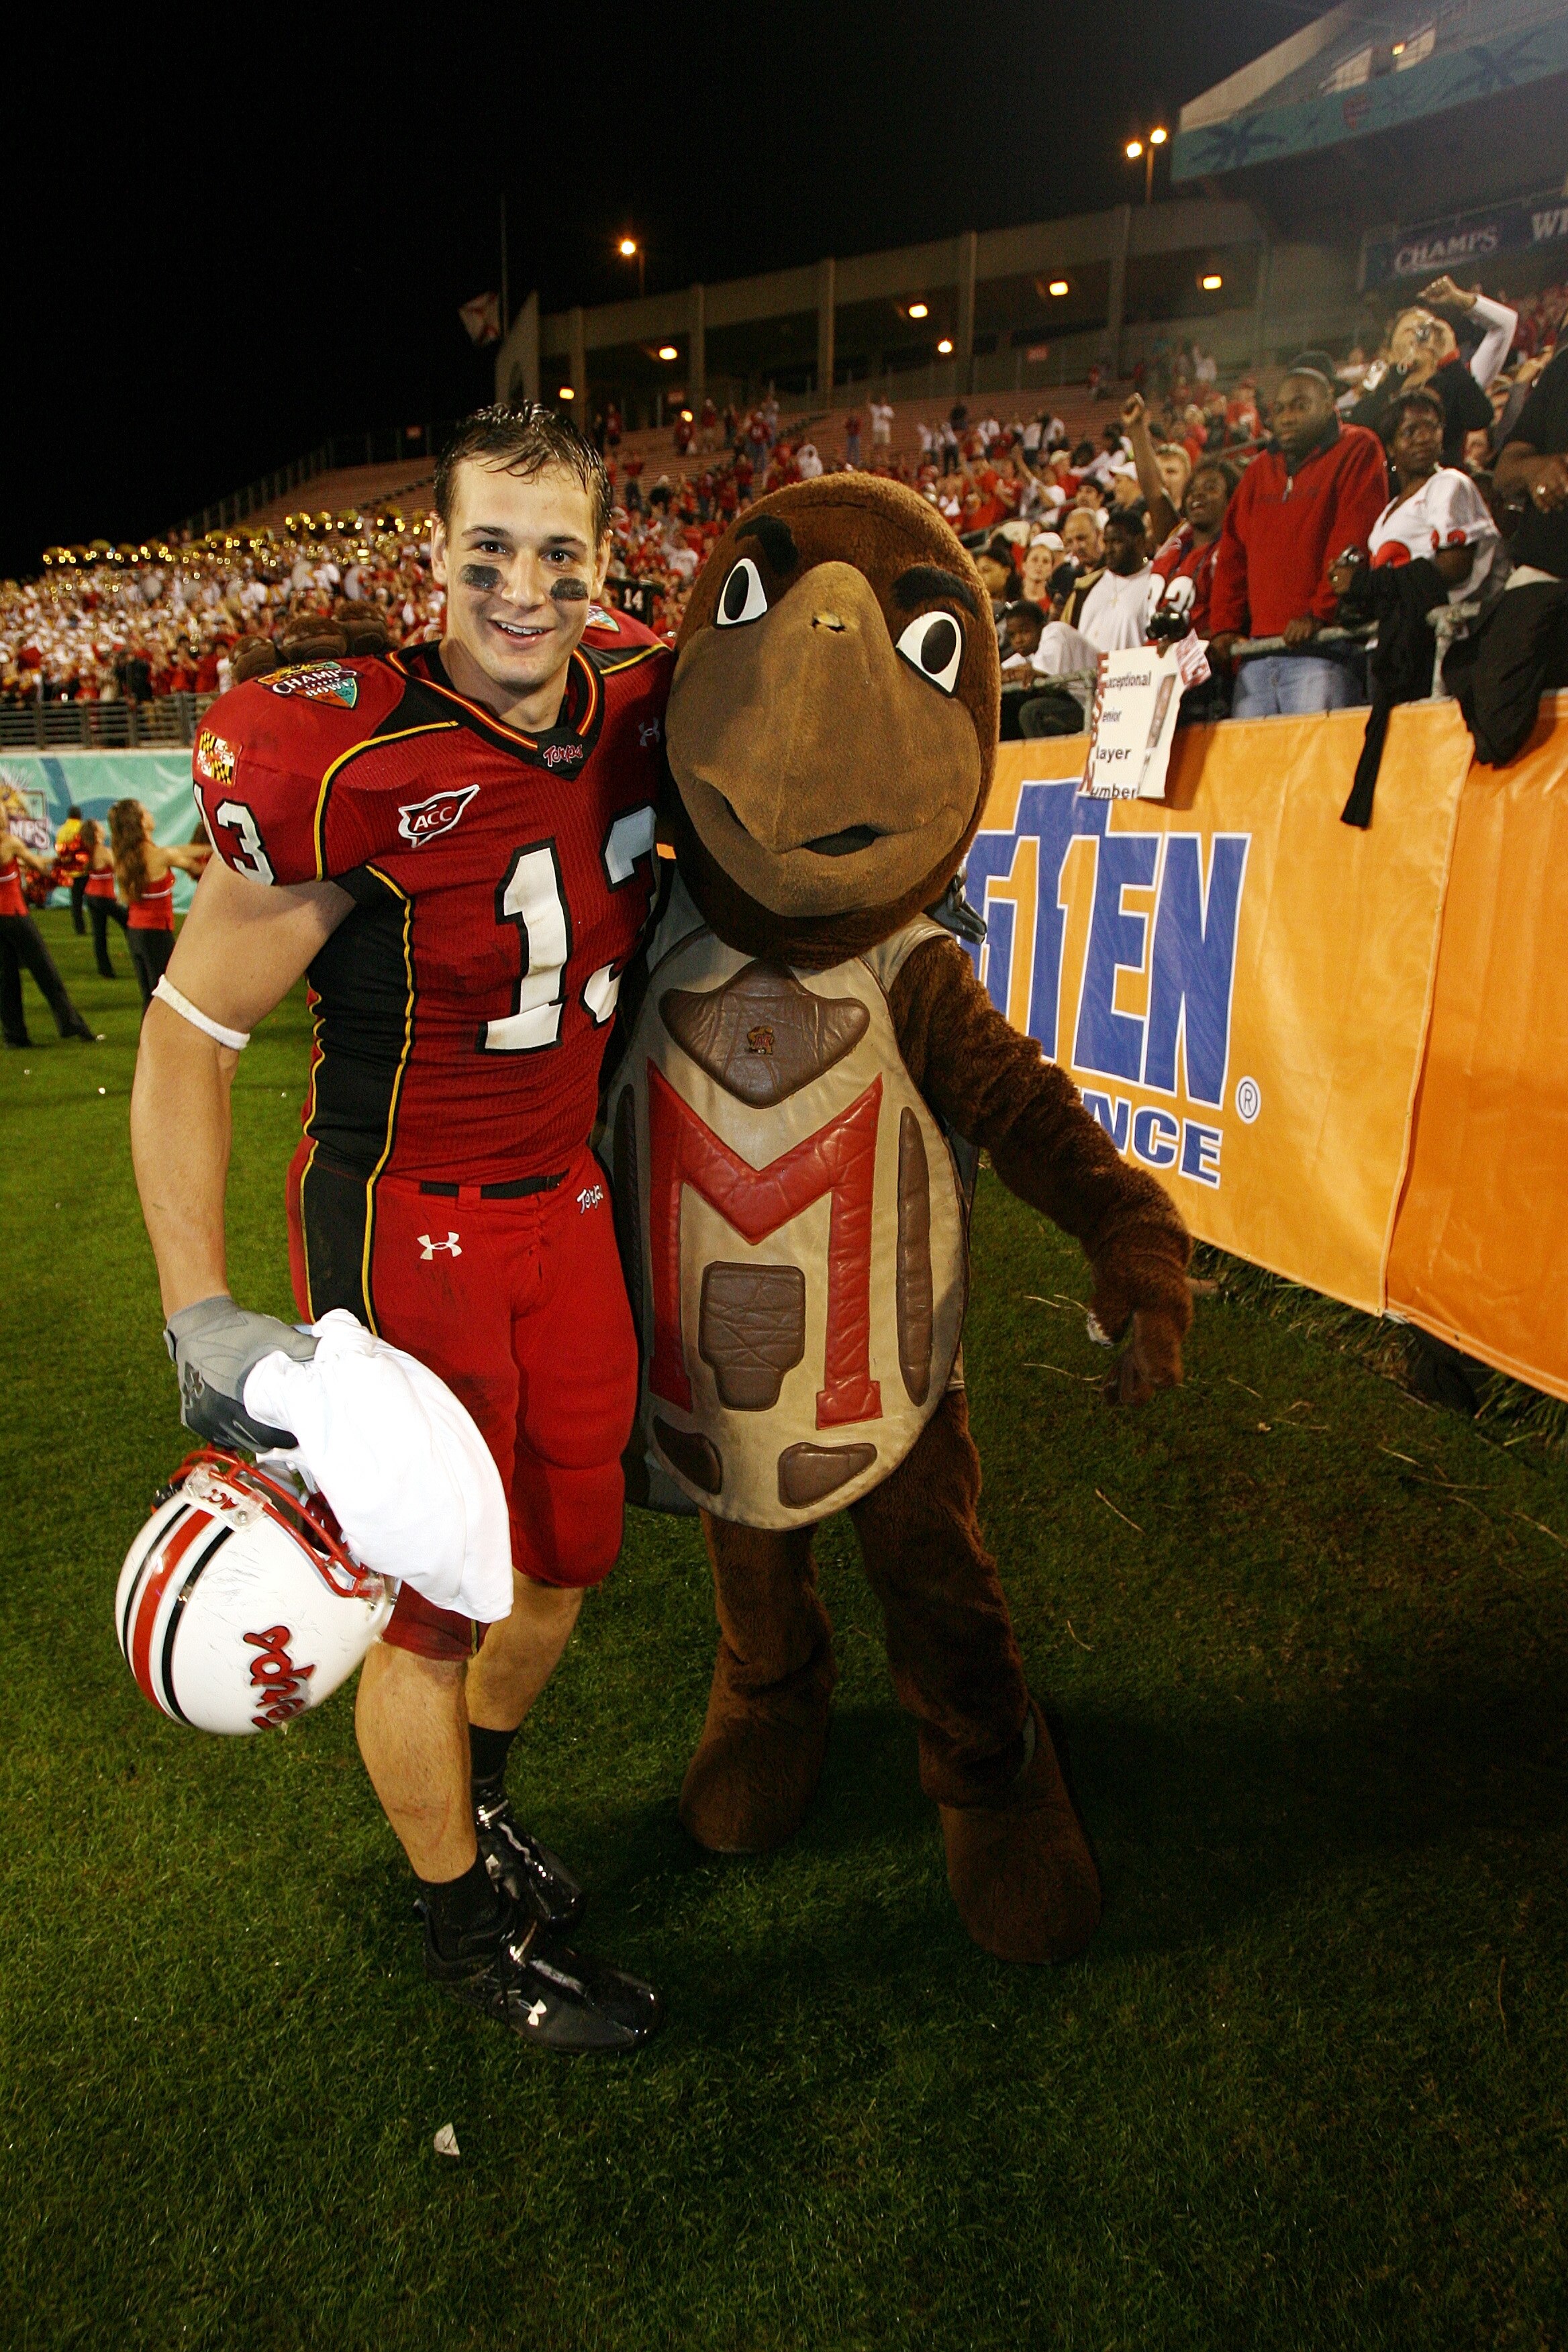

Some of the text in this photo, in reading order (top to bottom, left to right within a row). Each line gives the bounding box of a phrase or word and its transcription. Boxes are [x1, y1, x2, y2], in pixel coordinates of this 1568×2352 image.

[624, 588, 643, 611] 14
[273, 669, 357, 694] CHAMPS
[543, 744, 583, 767] Terps
[413, 806, 452, 832] ACC
